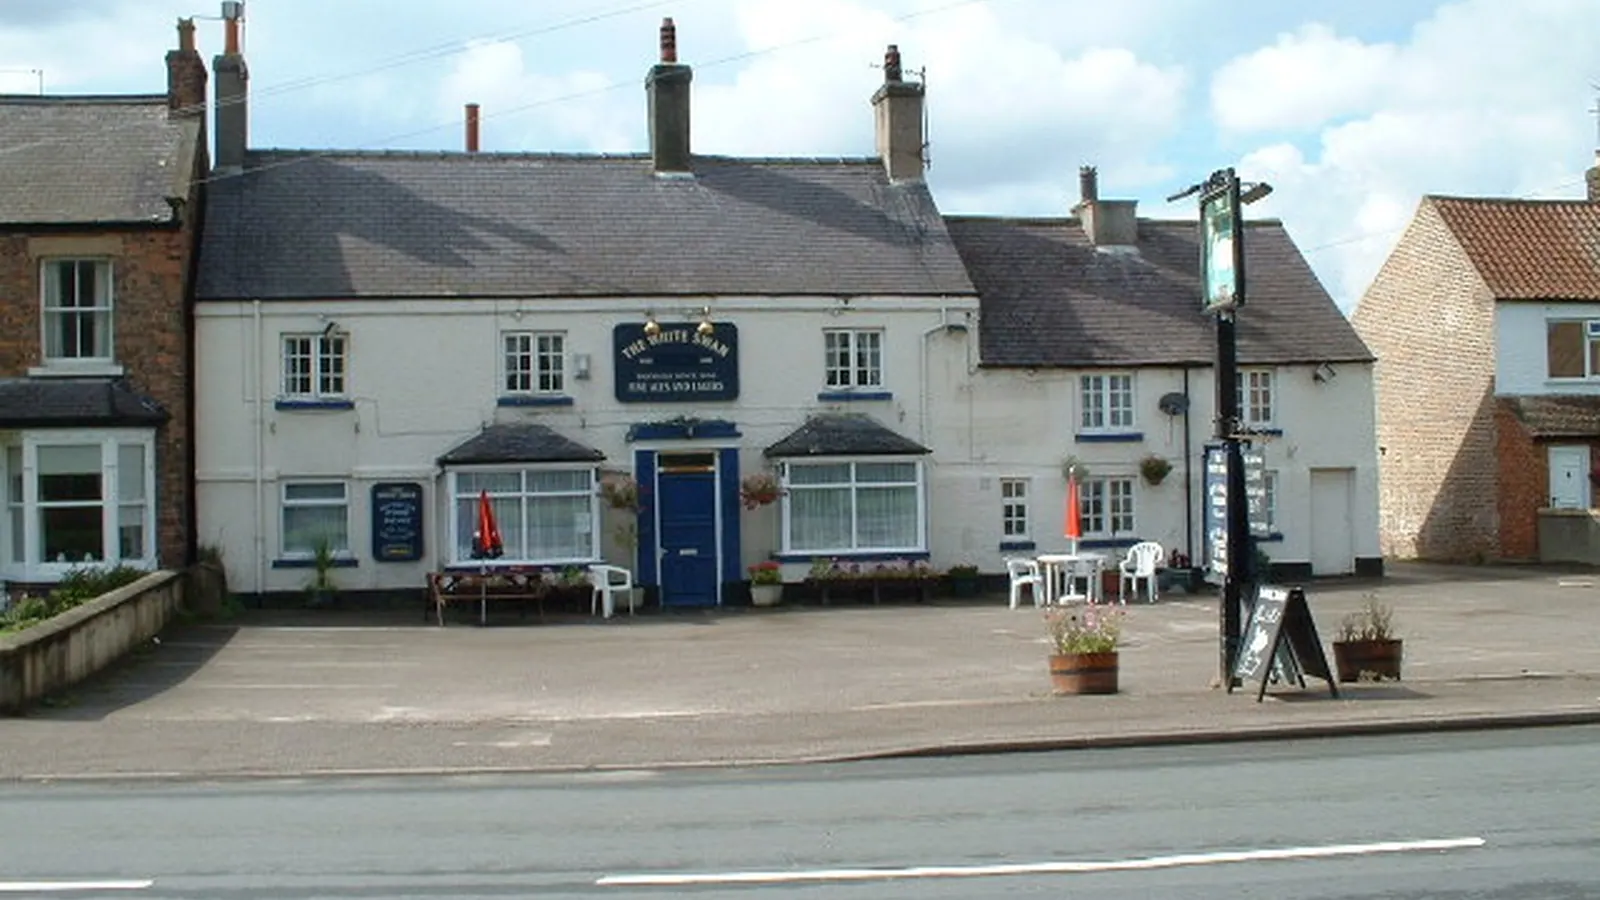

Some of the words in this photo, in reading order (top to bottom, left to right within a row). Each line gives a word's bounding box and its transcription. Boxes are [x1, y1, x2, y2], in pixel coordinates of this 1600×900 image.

[621, 338, 647, 359] THE
[646, 330, 688, 346] WHITE
[692, 331, 730, 358] SWAN
